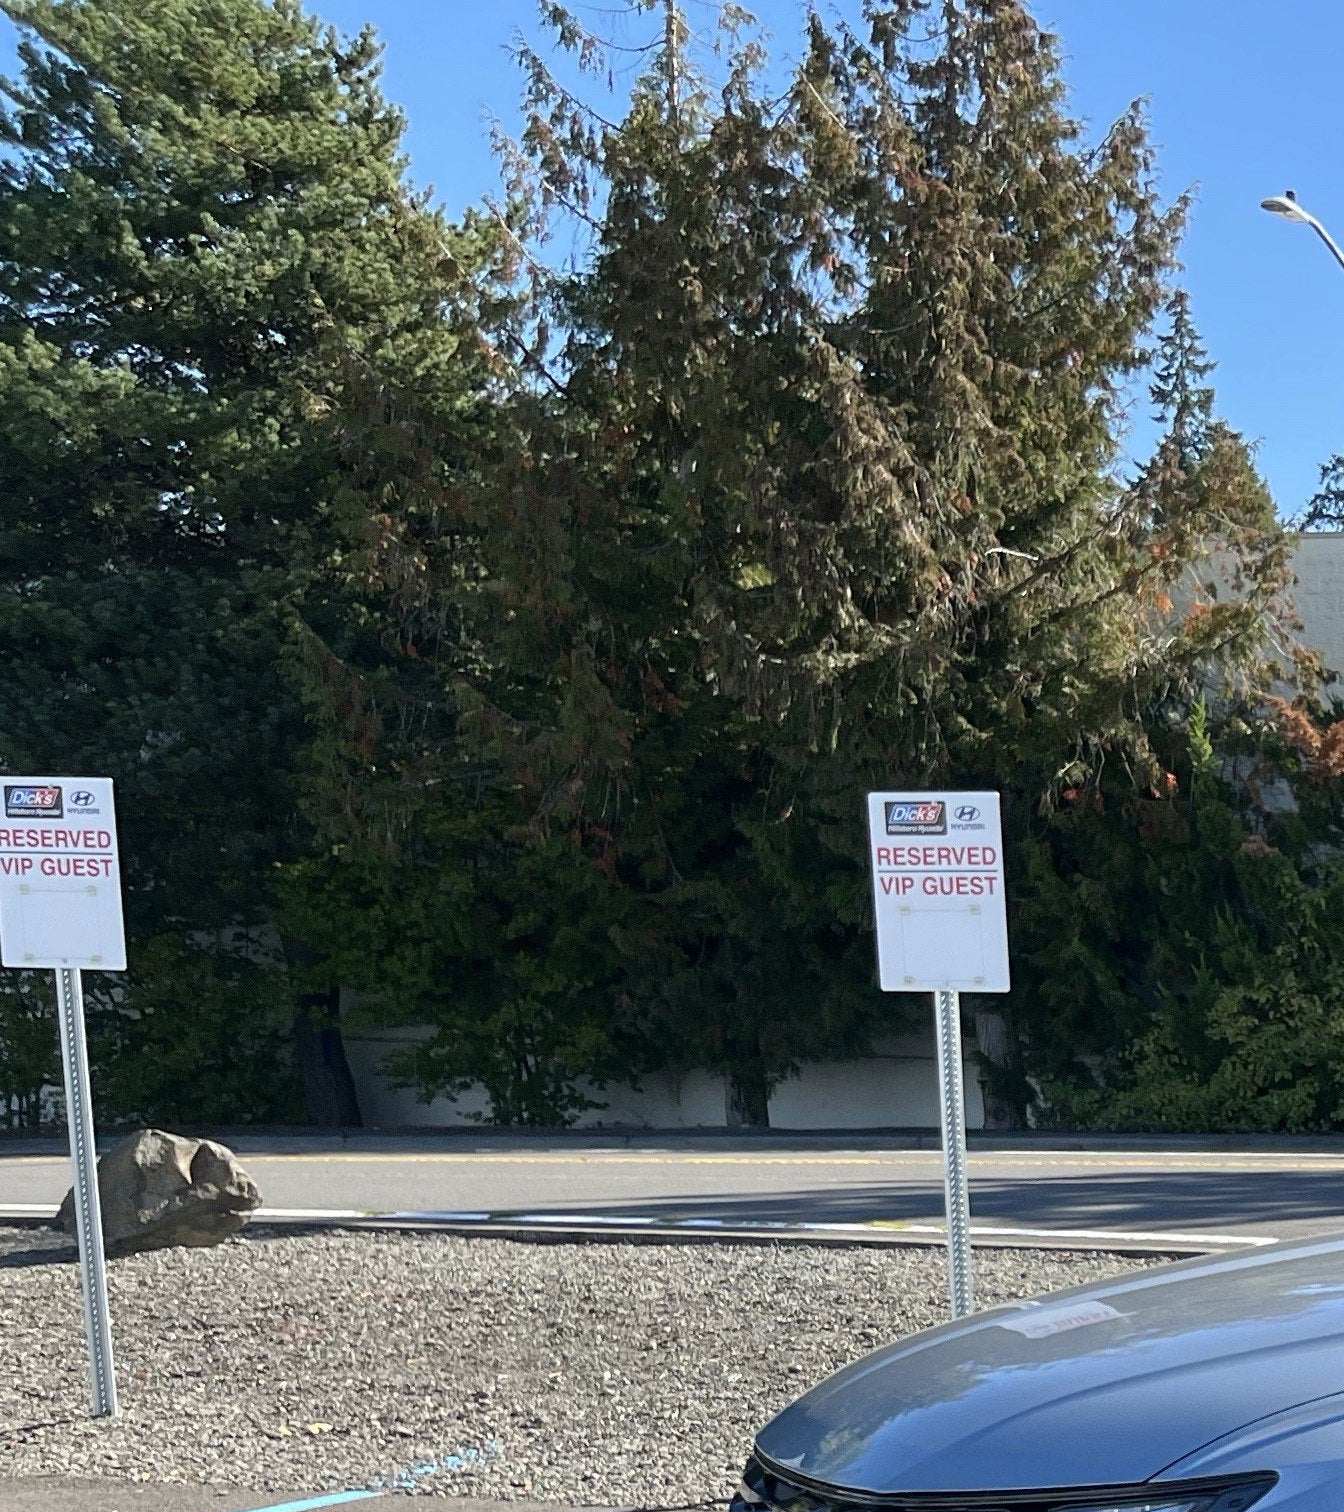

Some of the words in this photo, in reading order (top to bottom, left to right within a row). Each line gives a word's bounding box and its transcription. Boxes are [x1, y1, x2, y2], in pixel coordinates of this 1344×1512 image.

[0, 828, 111, 848] RESERVED
[877, 847, 997, 866] RESERVED
[1, 857, 33, 875] VIP
[41, 858, 112, 877] GUEST
[880, 877, 914, 895] VIP
[922, 876, 997, 896] GUEST
